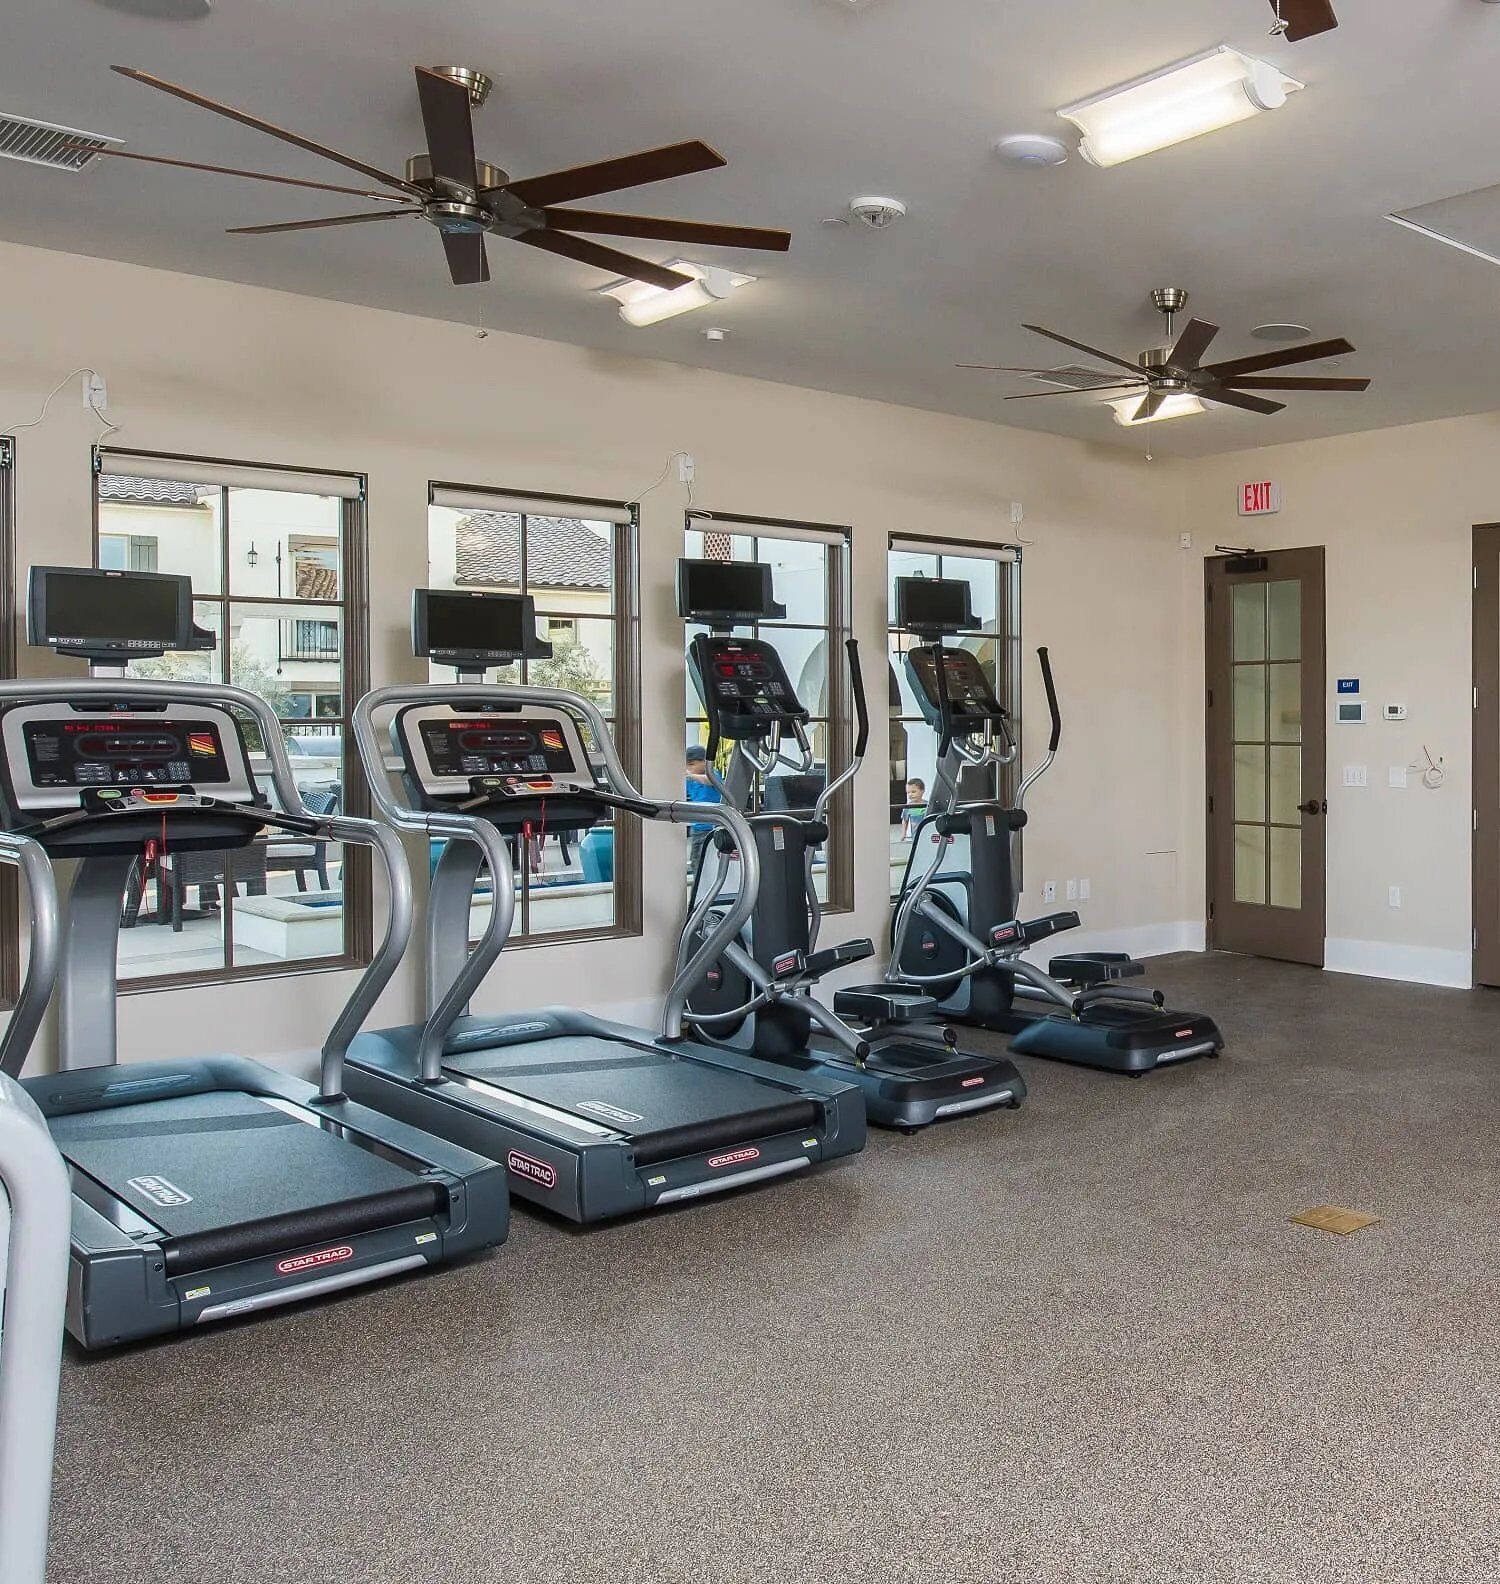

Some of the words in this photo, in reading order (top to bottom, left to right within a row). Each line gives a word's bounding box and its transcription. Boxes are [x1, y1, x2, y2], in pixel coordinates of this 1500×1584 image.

[1244, 482, 1271, 511] EXIT
[510, 1156, 530, 1172] STAR
[530, 1164, 551, 1181] TRAC
[283, 1257, 314, 1269] STAR
[314, 1249, 347, 1261] TRAC
